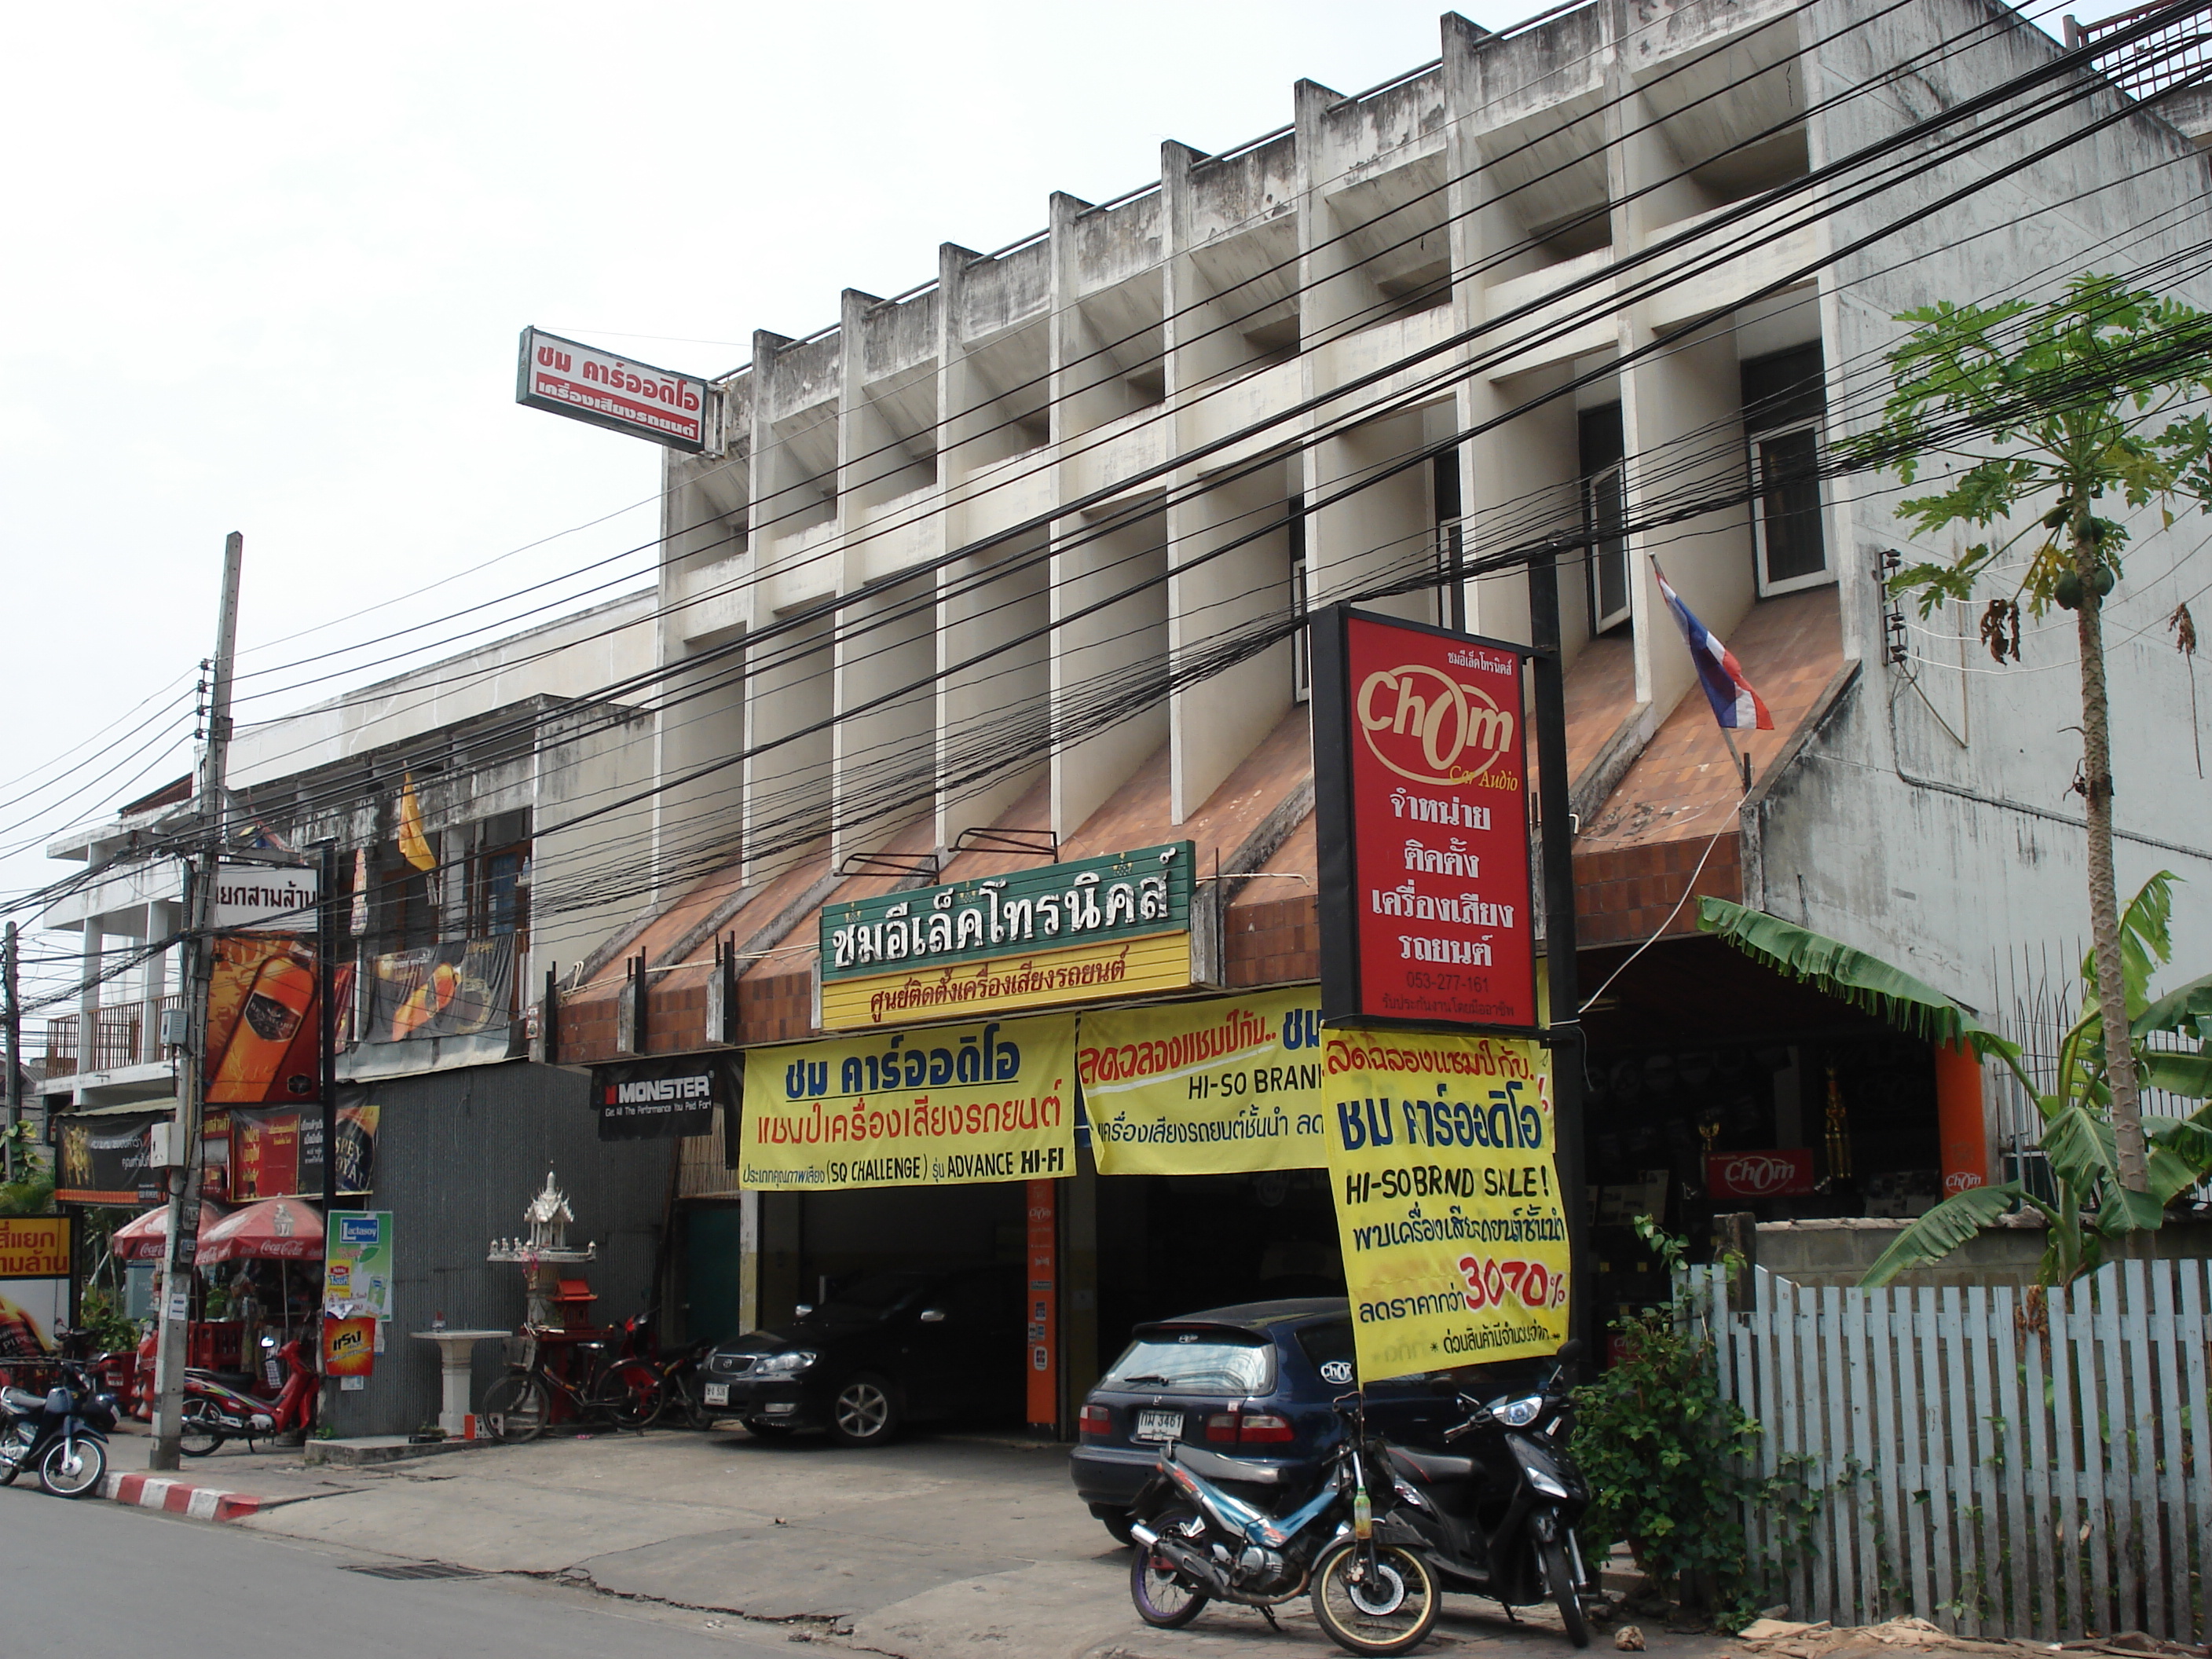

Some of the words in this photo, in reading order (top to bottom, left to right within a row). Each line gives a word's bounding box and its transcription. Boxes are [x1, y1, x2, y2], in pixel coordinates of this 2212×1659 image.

[537, 346, 571, 373] ชม
[583, 361, 699, 412] คาร์ออดิโอ
[538, 381, 694, 438] เครื่องเสียงรถยนต์
[1448, 650, 1512, 676] ชมอีเล็คโทรนิคส์
[1449, 765, 1476, 785] Car
[1478, 770, 1518, 792] Audio
[1390, 787, 1491, 830] จำหน่าย
[1404, 837, 1479, 878] ติดตั้ง
[832, 848, 1177, 968] ชมอีเล็คโทรนิคส์
[1372, 879, 1514, 928] เครื่องเสียง
[1398, 935, 1492, 966] รถยนต์
[870, 945, 1130, 1023] ศูนย์ติดตั้งเครื่องเสียงรถยนต์
[1406, 971, 1489, 993] 053-277-161
[786, 1058, 828, 1100] ชม
[841, 1023, 1020, 1093] คาร์ออดิโอ
[1188, 1071, 1247, 1100] HI-SO
[1254, 1064, 1322, 1093] BRAN
[605, 1108, 615, 1117] Get
[624, 1106, 636, 1115] The
[637, 1104, 672, 1115] Performance
[674, 1102, 683, 1111] You
[618, 1075, 710, 1104] MONSTER
[1337, 1098, 1394, 1152] ชม
[1402, 1081, 1543, 1149] คาร์ออดิโอ
[851, 1152, 928, 1181] CHALLENGE)
[947, 1152, 1013, 1178] ADVANCE
[1020, 1147, 1064, 1174] HI-FI
[260, 1239, 304, 1257] Coca-Cola
[1359, 1283, 1467, 1324] ลดราคากว่า
